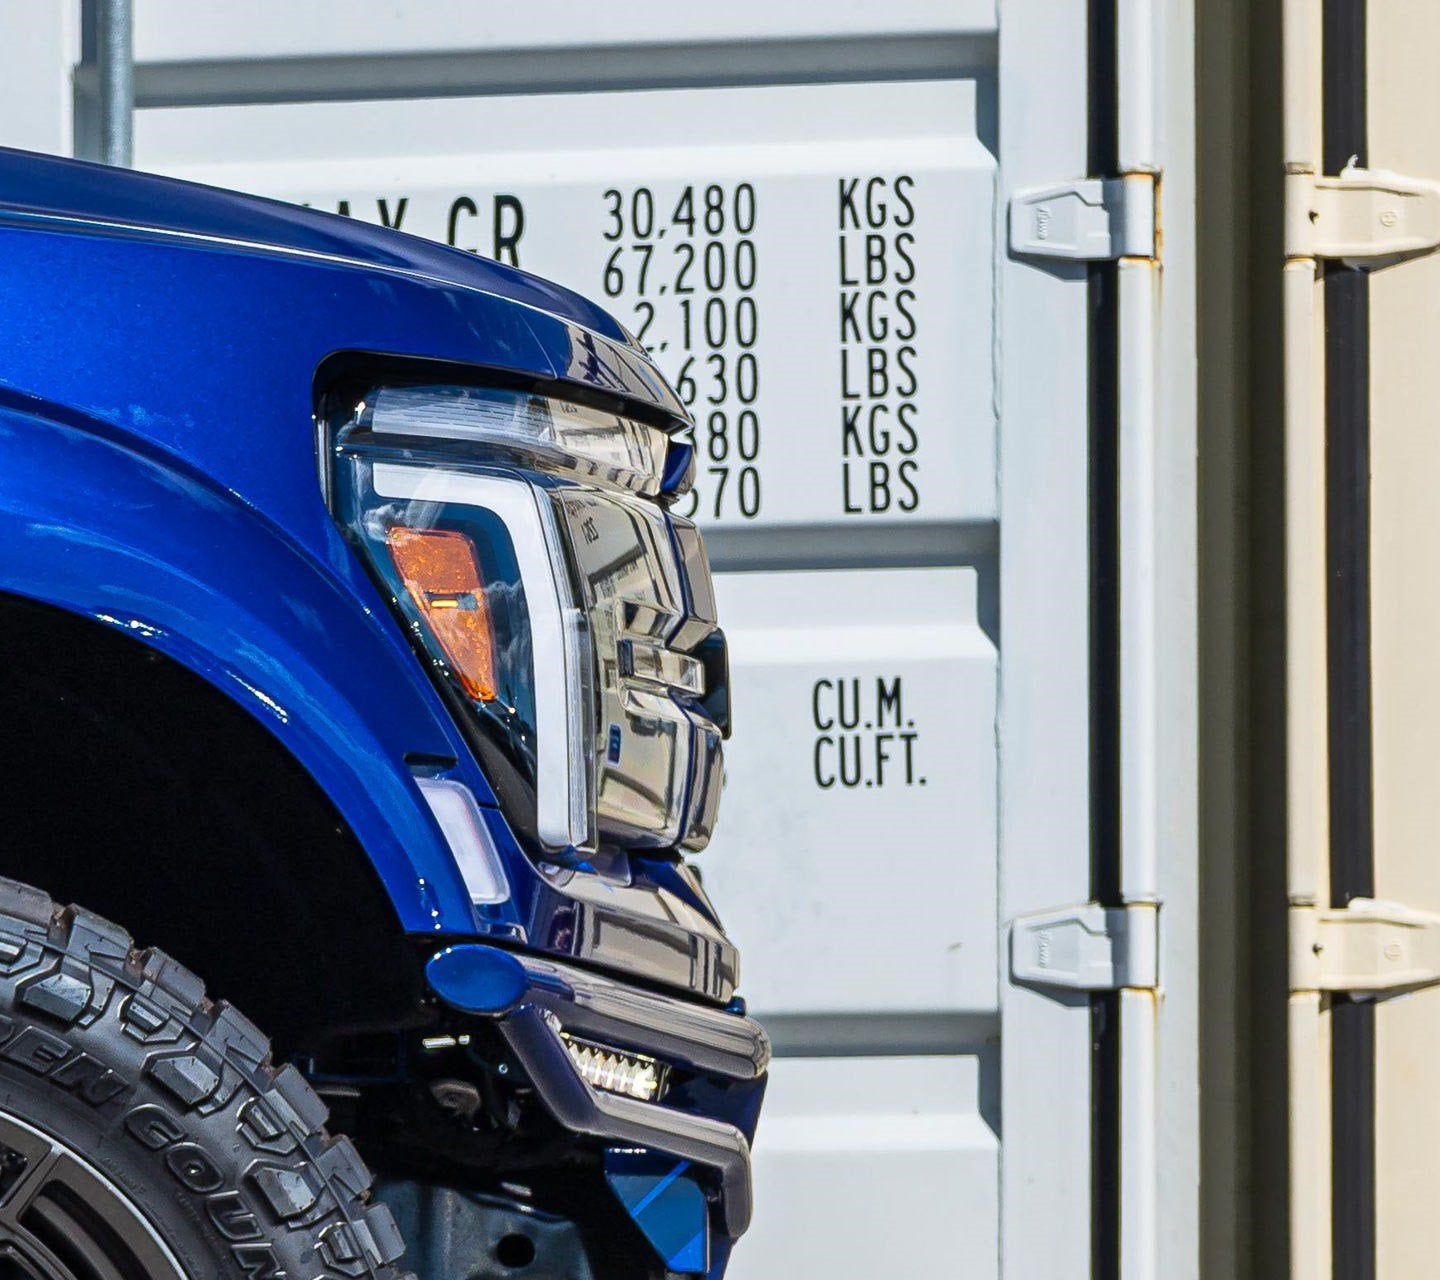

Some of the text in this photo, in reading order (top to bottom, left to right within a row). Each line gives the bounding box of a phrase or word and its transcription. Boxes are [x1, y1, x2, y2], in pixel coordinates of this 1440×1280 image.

[603, 182, 757, 242] 30,480
[839, 175, 916, 230] KGS
[603, 232, 917, 298] 67,200 LBS
[839, 289, 917, 344] KGS
[841, 345, 918, 401] LBS
[842, 402, 919, 458] KGS
[843, 460, 919, 515] LBS
[812, 677, 915, 732] CU.M.
[814, 733, 927, 789] CU.FT.
